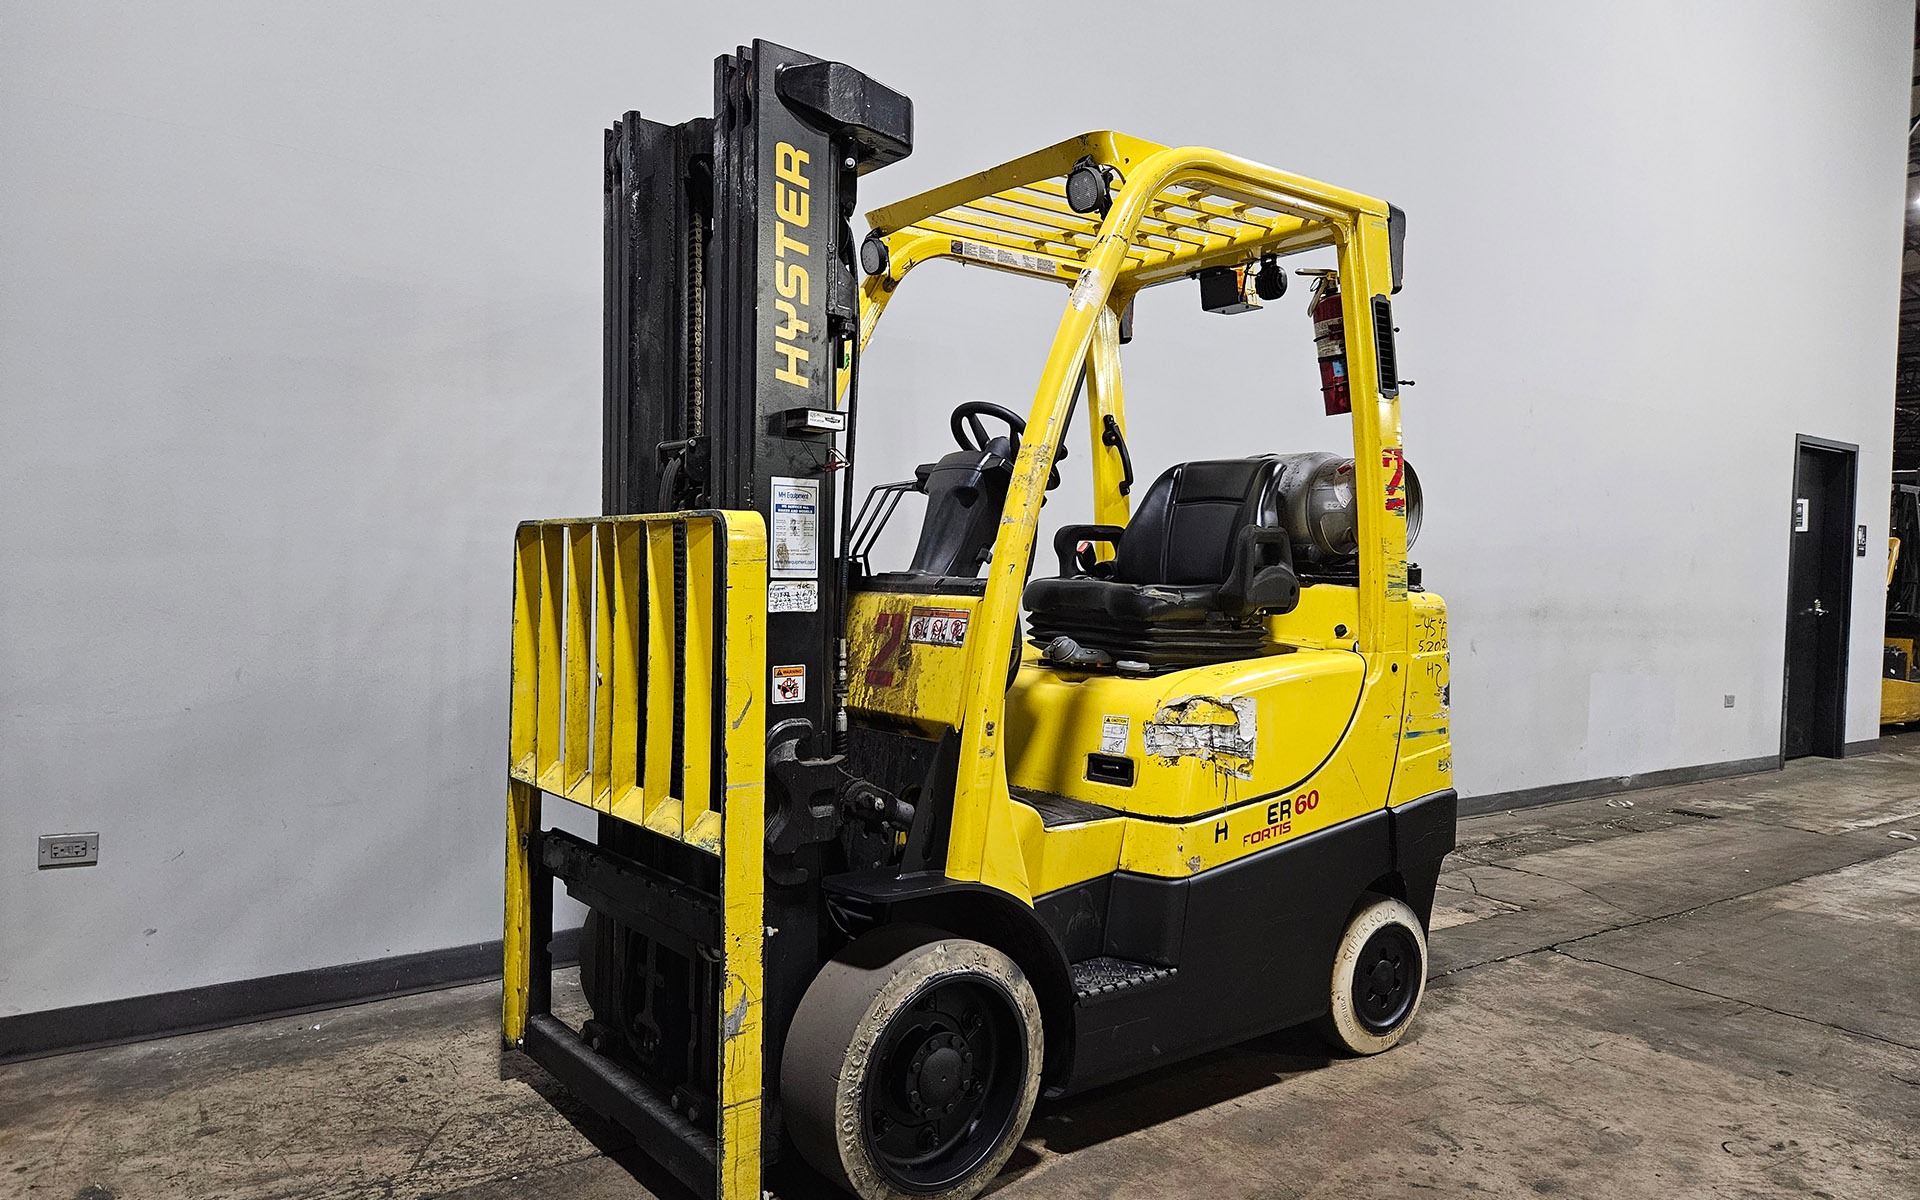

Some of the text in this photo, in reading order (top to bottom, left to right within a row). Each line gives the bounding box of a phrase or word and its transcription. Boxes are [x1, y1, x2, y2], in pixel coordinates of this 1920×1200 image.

[775, 141, 809, 389] HYSTER
[787, 492, 809, 500] Equipment
[865, 613, 905, 687] 2
[1294, 790, 1319, 815] 60
[1243, 821, 1291, 847] FORTIS
[1343, 907, 1397, 962] SUPER SOLID
[842, 1037, 868, 1151] MONARCH
